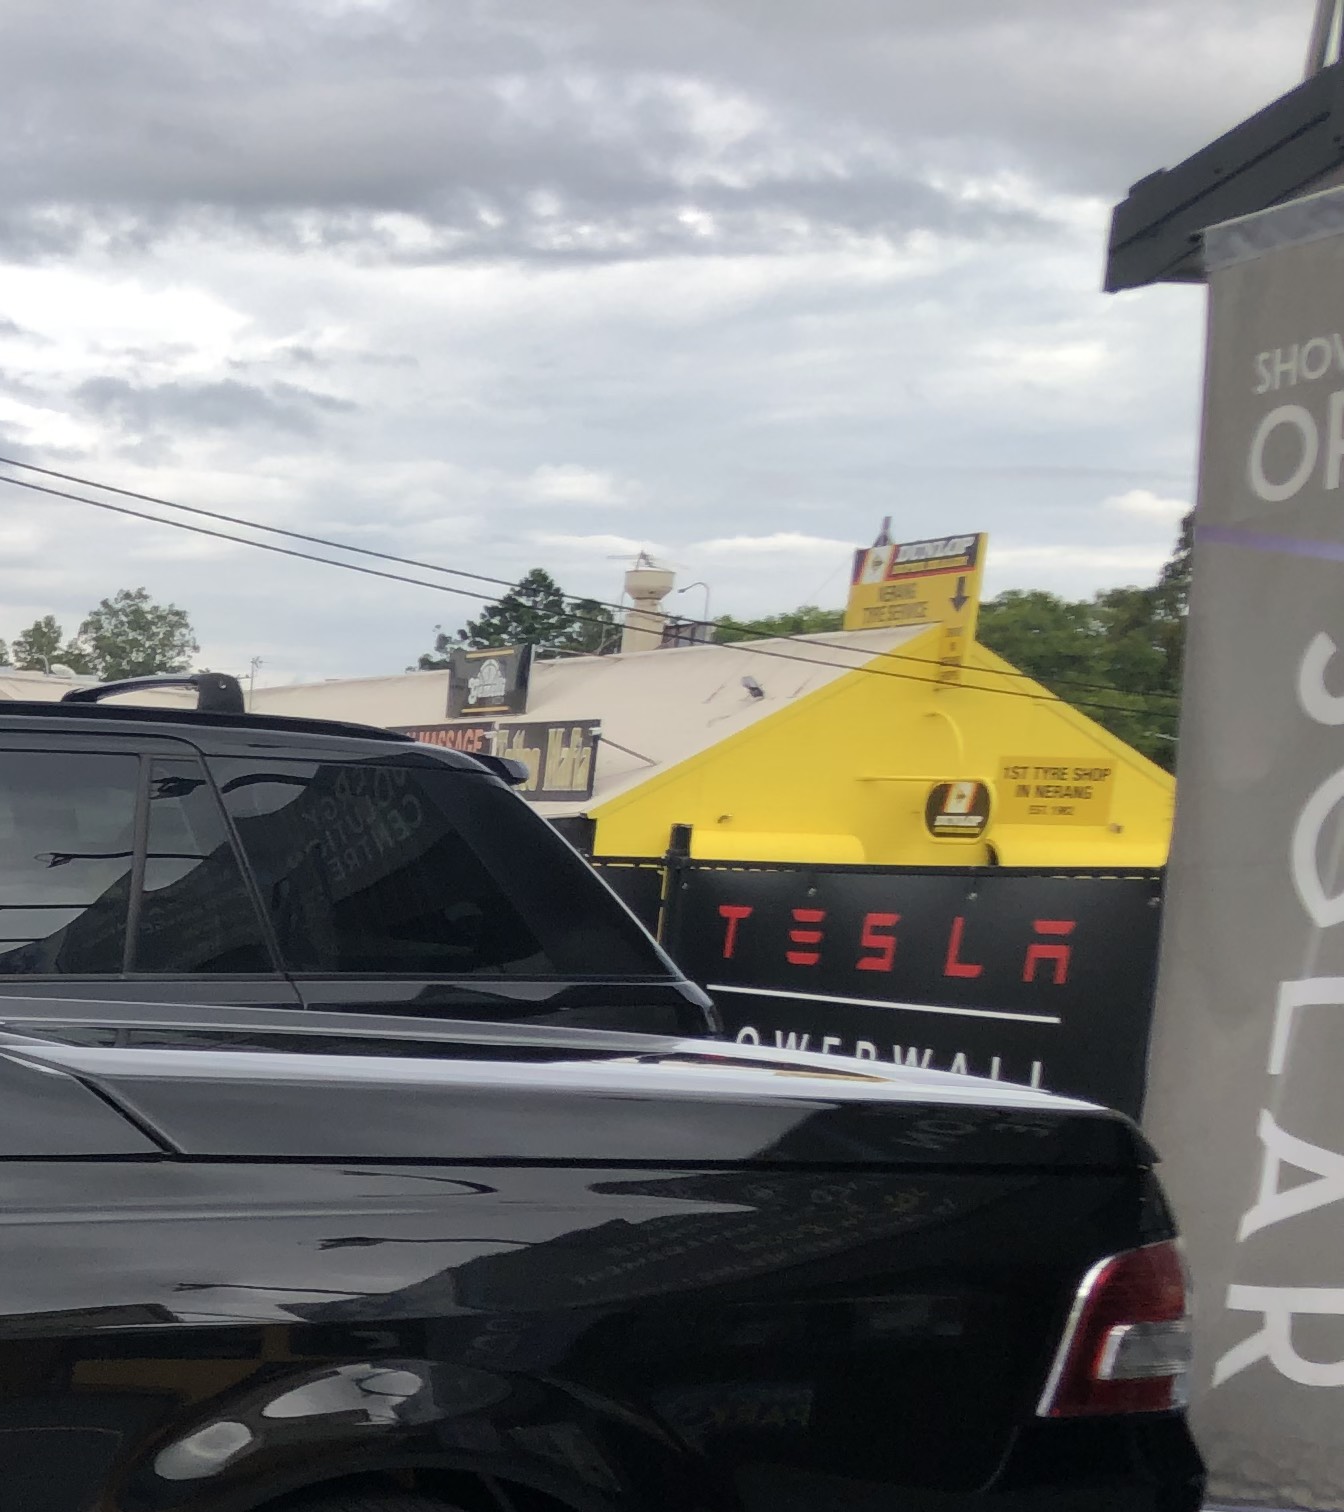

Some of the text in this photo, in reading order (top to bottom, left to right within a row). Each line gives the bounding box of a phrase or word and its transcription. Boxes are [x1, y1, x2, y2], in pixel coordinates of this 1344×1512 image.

[1252, 333, 1344, 394] SHO
[1015, 784, 1094, 800] IN NERANG
[1033, 767, 1069, 781] TYRE
[1073, 768, 1112, 782] SHOP
[718, 904, 1077, 985] TESLA
